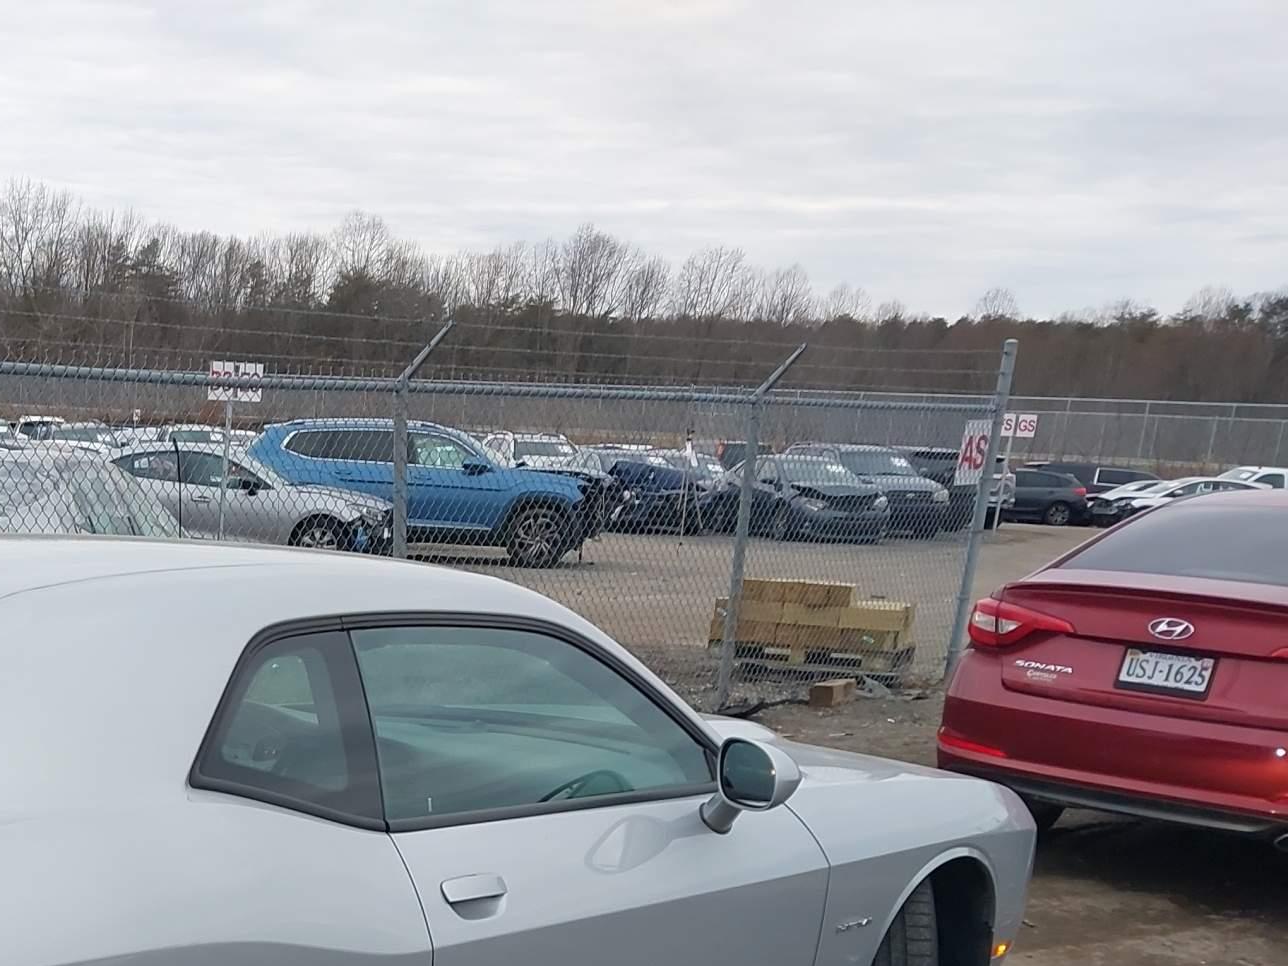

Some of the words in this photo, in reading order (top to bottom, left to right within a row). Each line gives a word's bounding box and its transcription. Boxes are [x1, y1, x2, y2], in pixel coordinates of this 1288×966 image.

[1018, 419, 1036, 433] GS
[958, 433, 989, 471] AS
[1015, 659, 1073, 674] SONATA
[1126, 657, 1208, 687] USJ-1625
